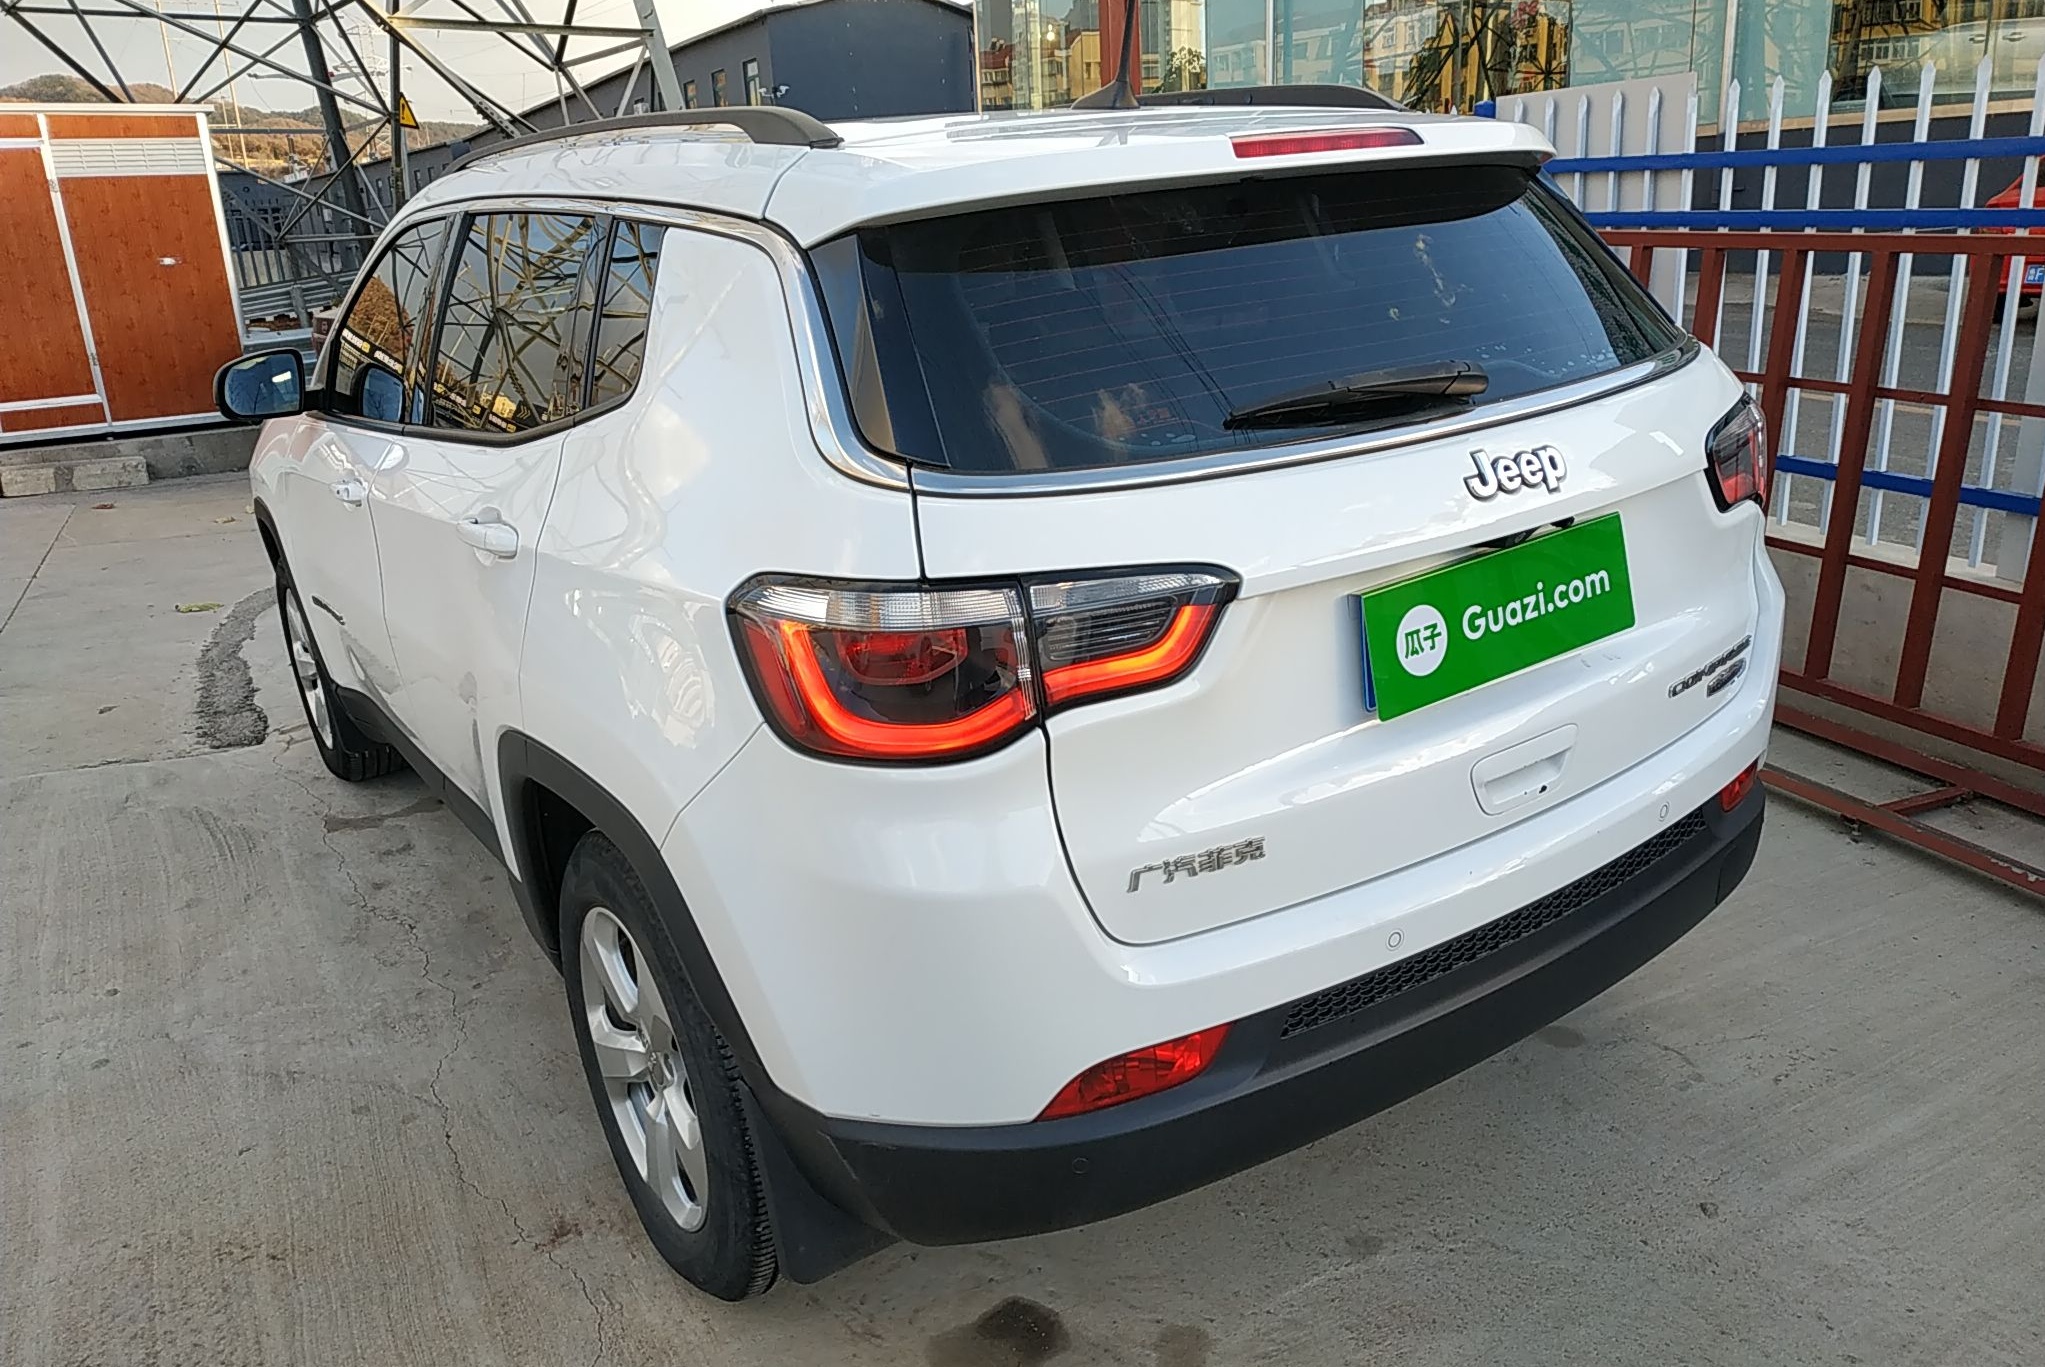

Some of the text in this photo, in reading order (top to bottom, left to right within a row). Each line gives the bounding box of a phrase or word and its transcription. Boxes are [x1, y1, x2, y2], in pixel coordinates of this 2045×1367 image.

[1464, 445, 1567, 501] Jeep
[1462, 569, 1610, 640] Guazi.com
[1404, 622, 1442, 659] 瓜子
[1126, 836, 1266, 893] 广汽菲克
